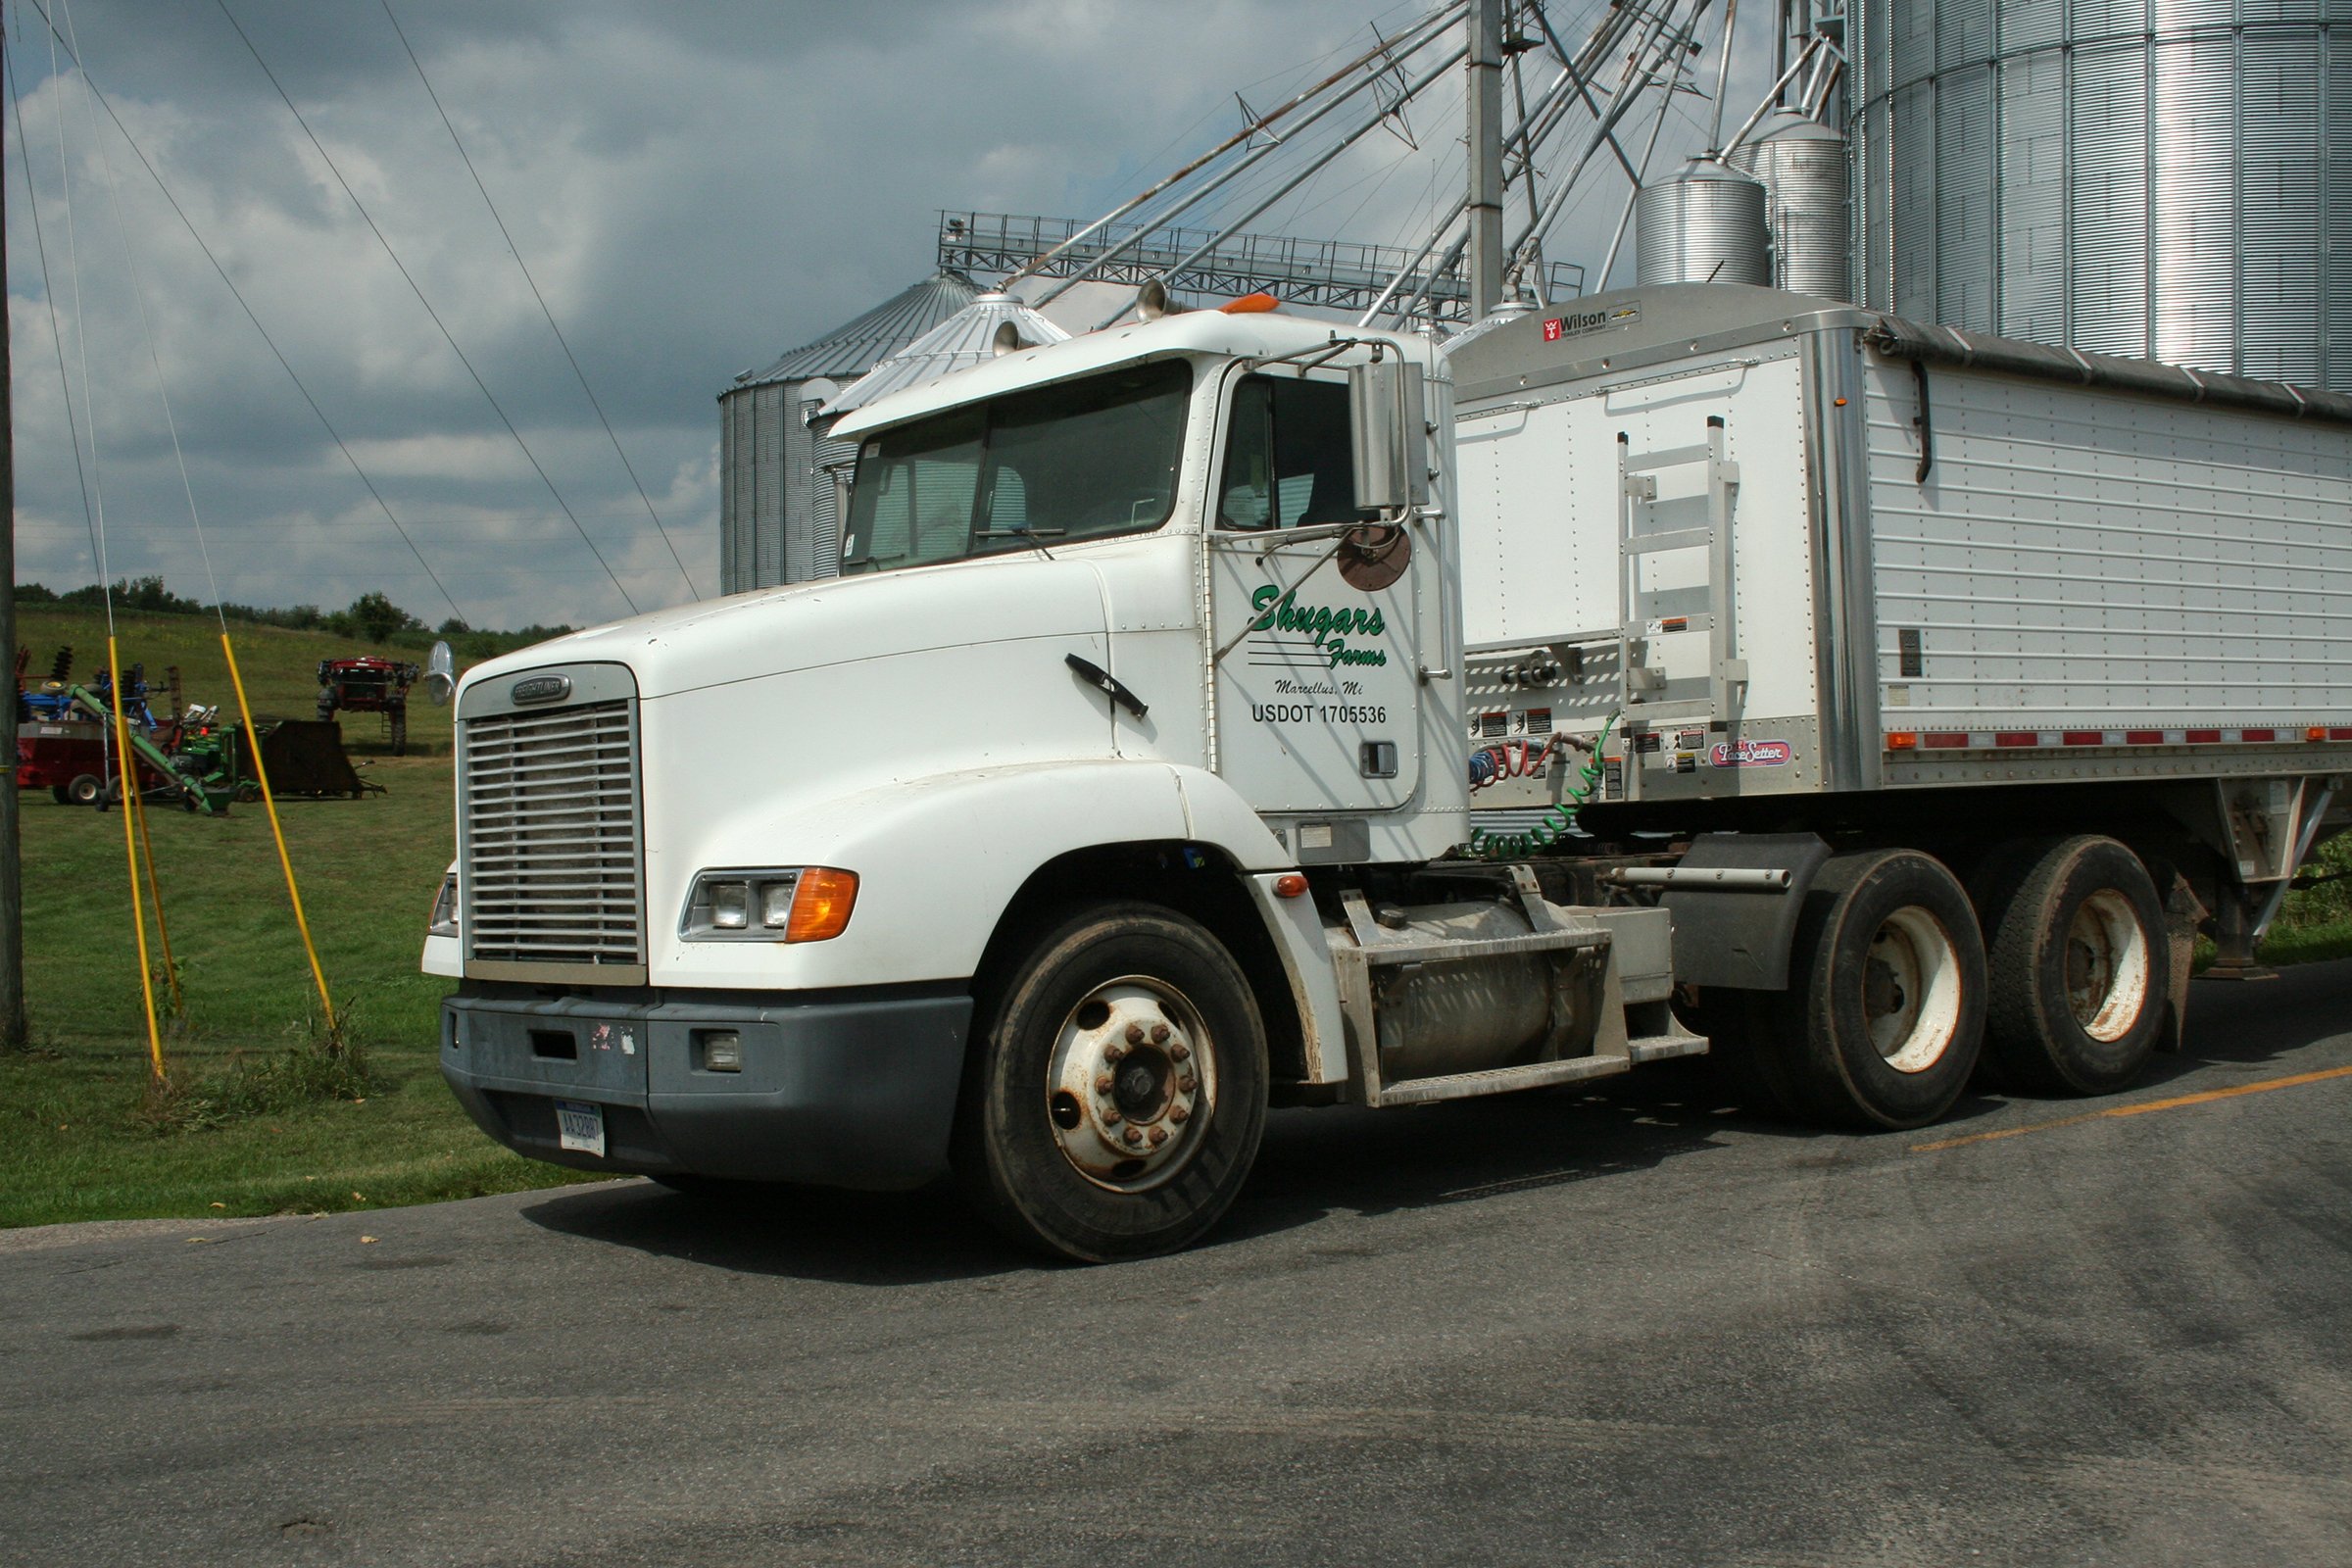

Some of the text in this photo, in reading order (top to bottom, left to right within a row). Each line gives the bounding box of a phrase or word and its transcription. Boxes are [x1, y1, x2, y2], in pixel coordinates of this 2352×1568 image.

[1560, 312, 1606, 331] Wilson
[1582, 324, 1606, 333] COMPANY
[1248, 584, 1386, 648] Shugars
[1327, 638, 1387, 669] Farms
[1343, 681, 1363, 696] Mi
[1251, 704, 1387, 723] USDOT 1705536
[1718, 740, 1784, 762] PaceSetter
